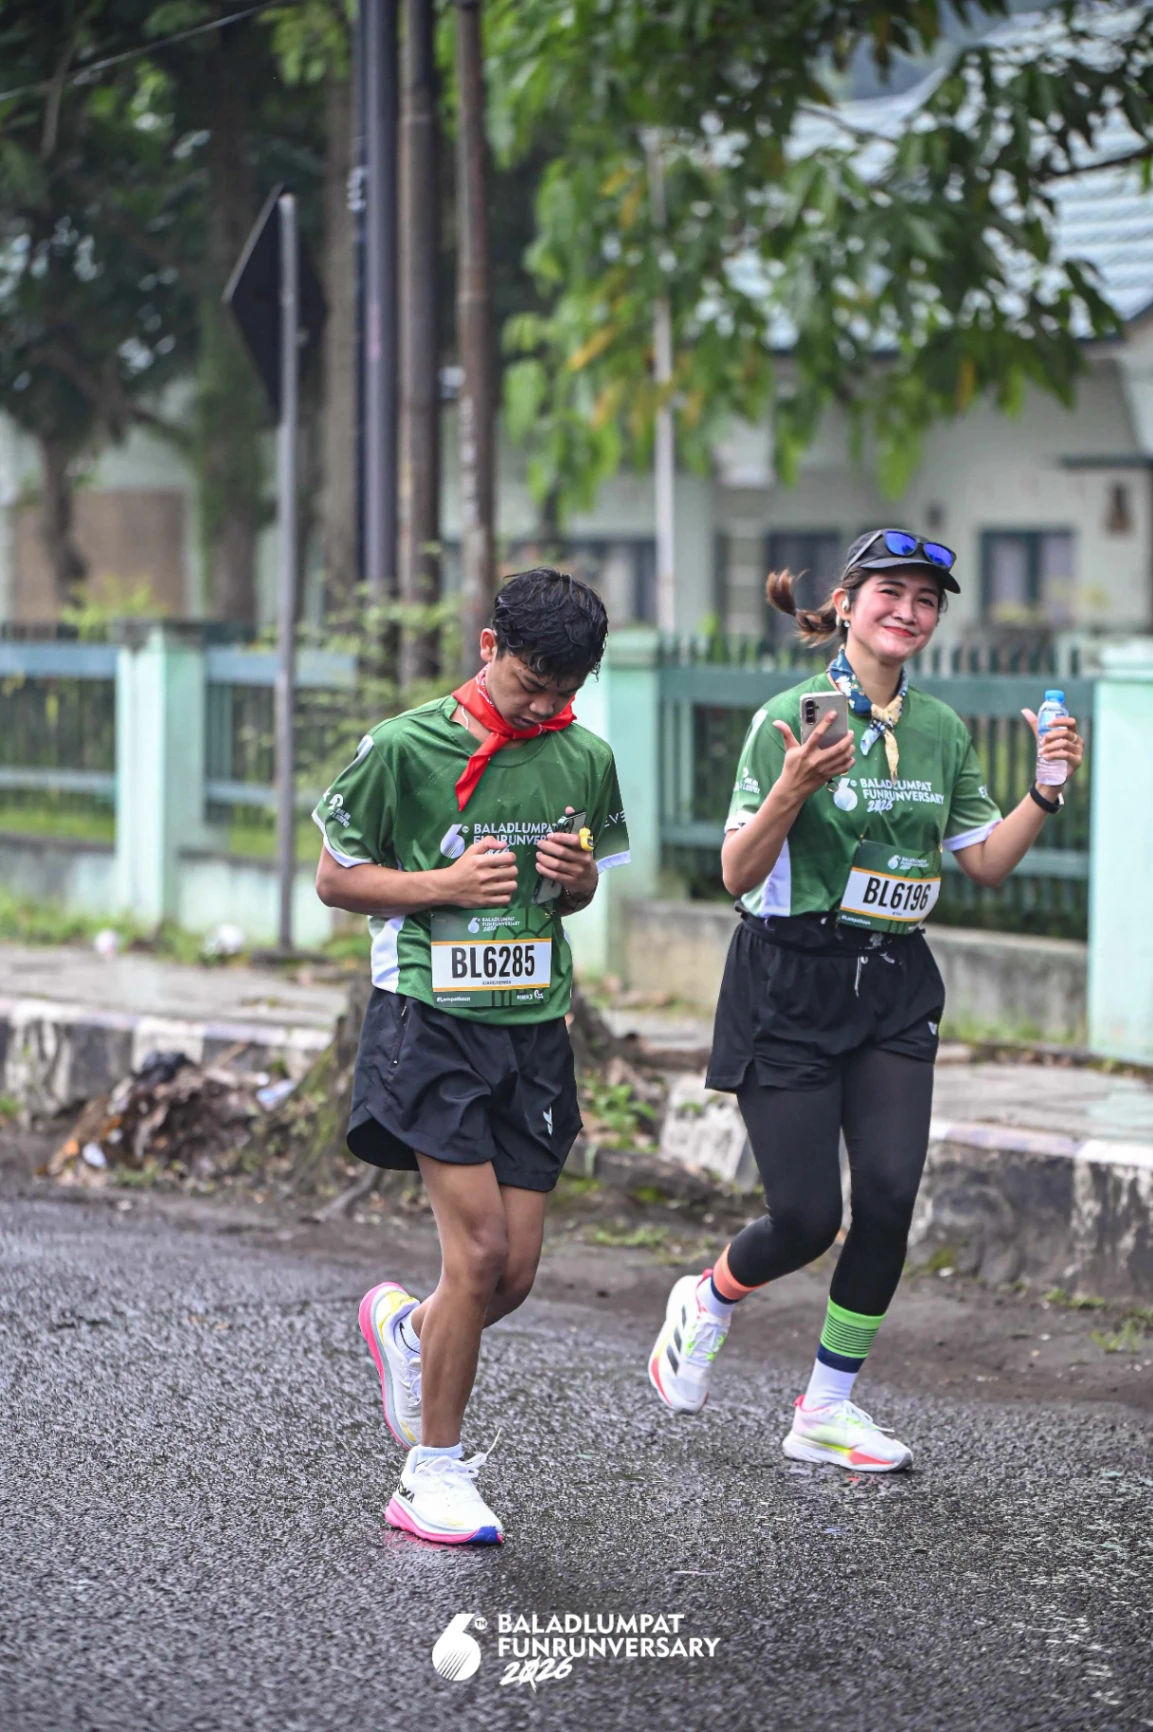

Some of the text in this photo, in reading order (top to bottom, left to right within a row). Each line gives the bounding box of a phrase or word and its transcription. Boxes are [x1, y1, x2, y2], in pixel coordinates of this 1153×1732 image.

[860, 778, 932, 791] BALADLUMPAT
[863, 788, 944, 804] FUNRUNVERSARY
[862, 876, 931, 911] BL6196
[451, 945, 535, 978] BL6285
